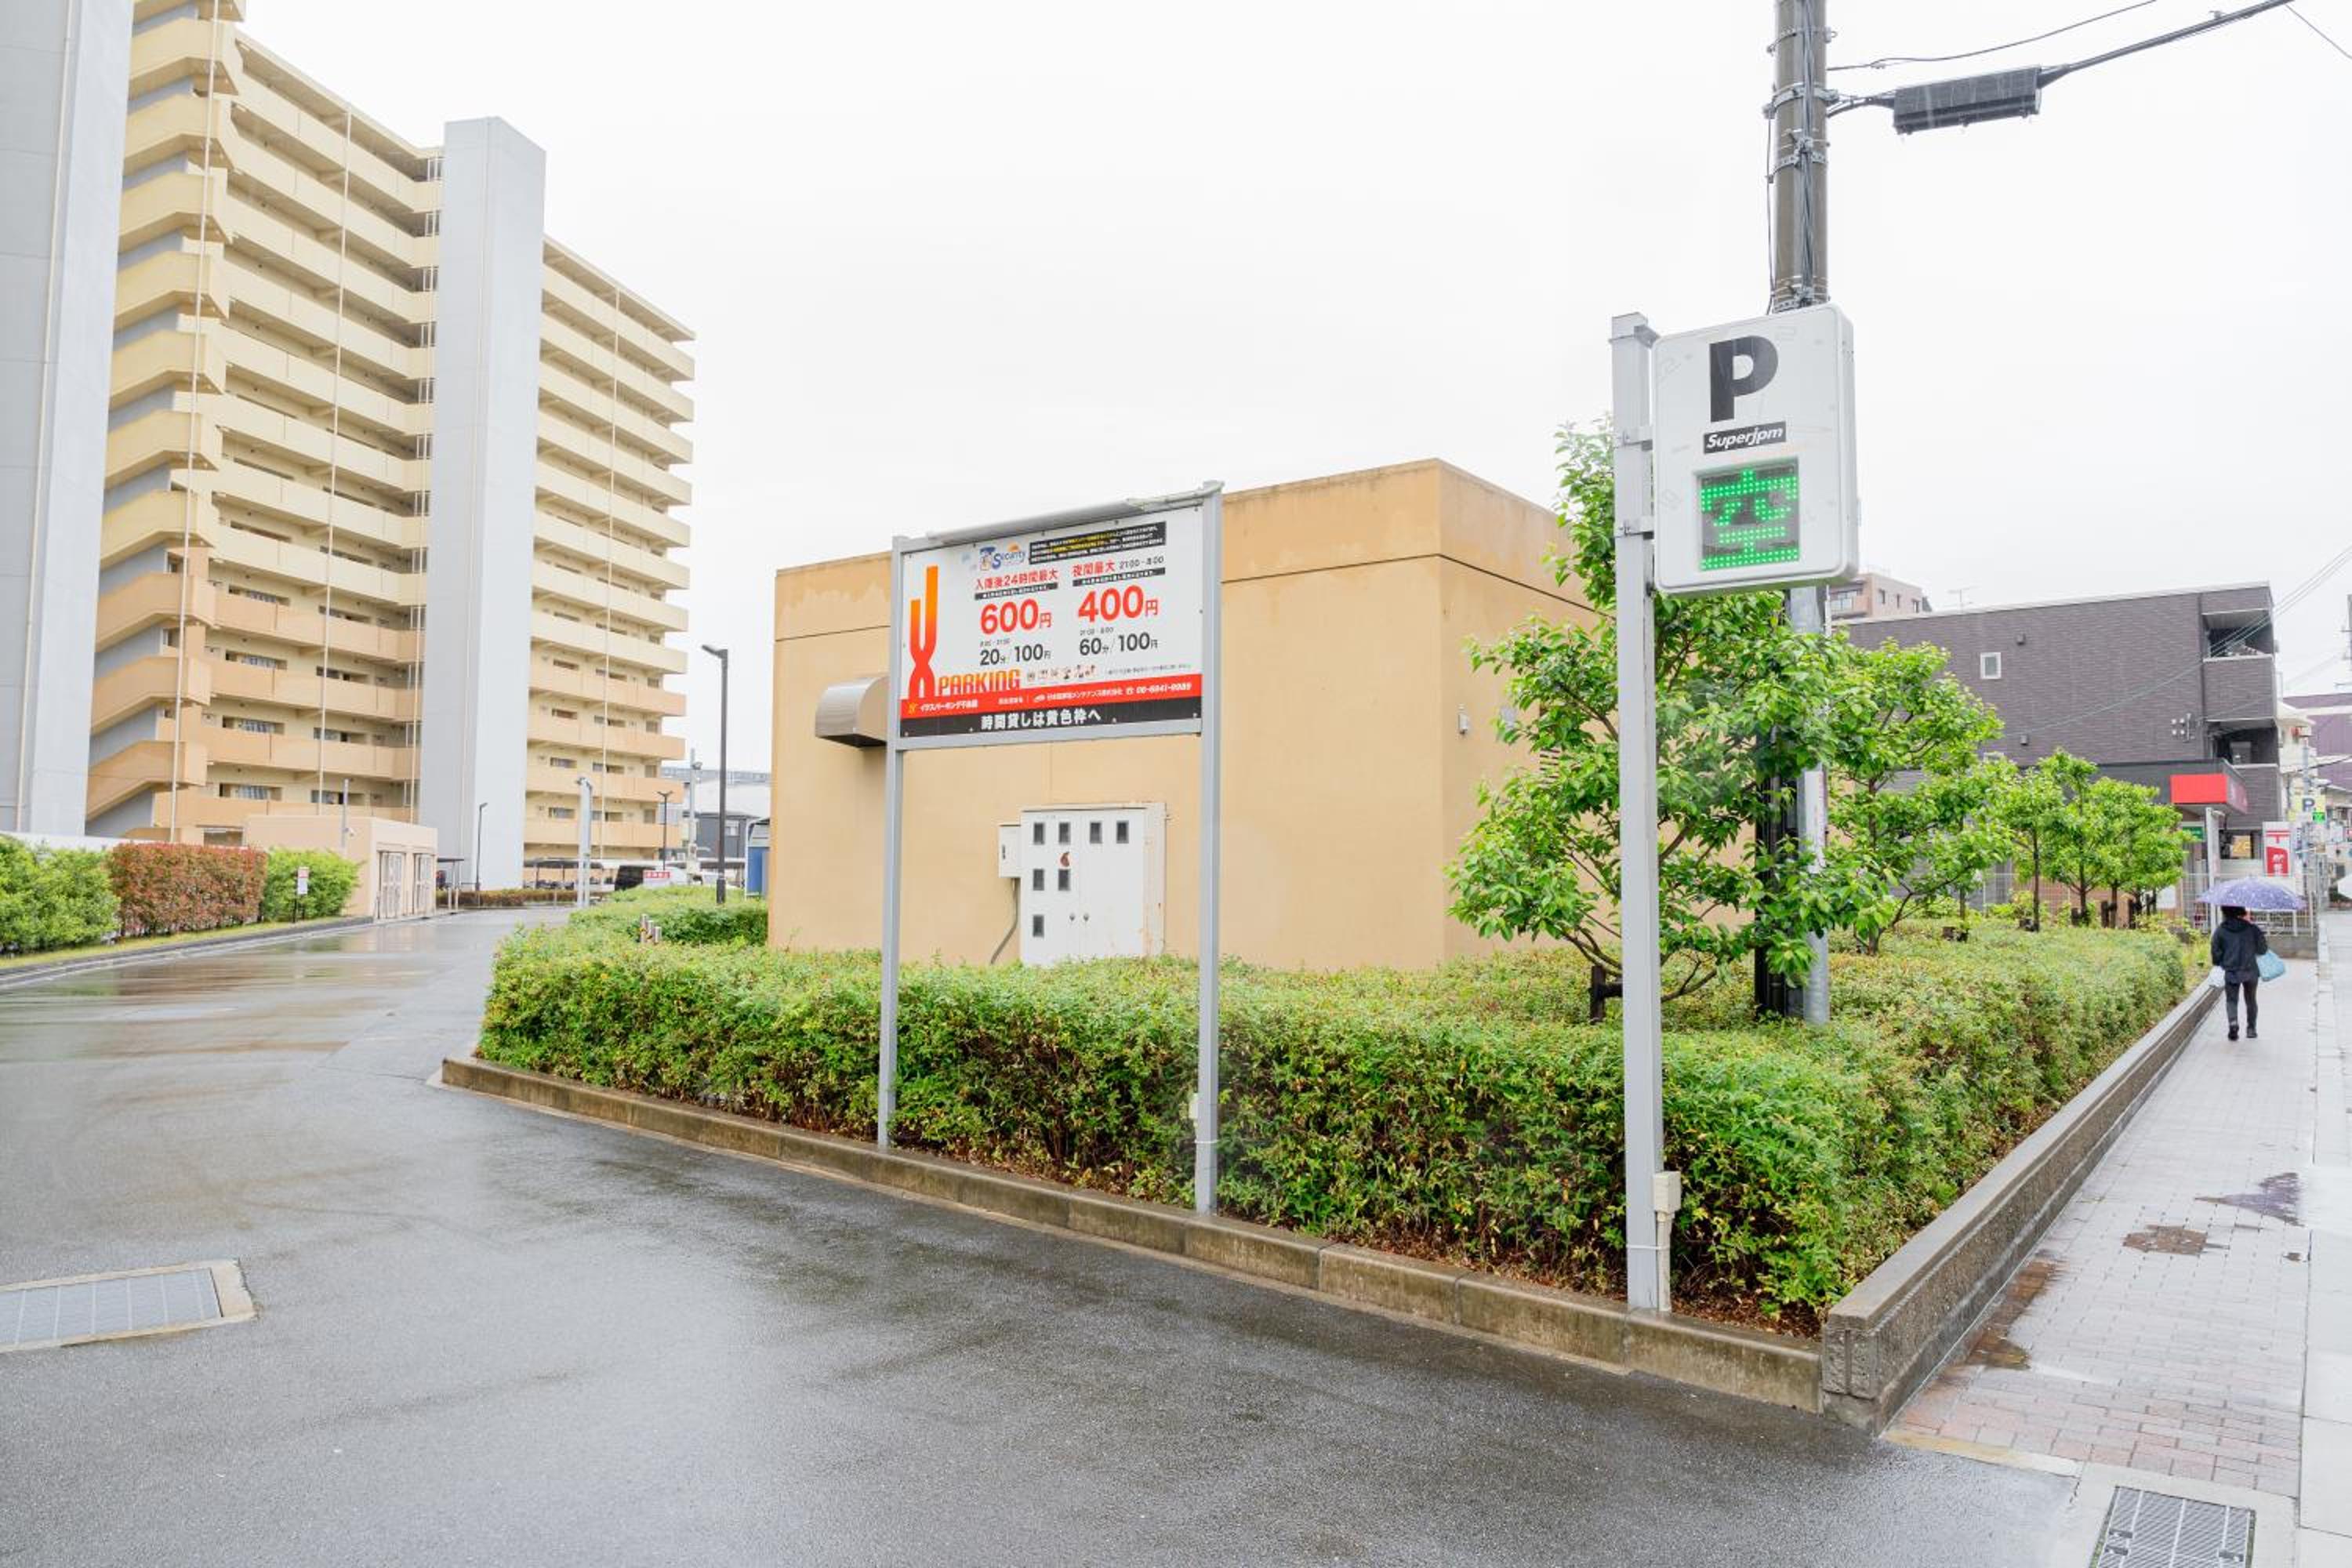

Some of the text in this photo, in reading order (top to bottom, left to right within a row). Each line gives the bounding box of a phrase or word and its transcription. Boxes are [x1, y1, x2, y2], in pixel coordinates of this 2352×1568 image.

[1709, 335, 1779, 423] P
[1706, 425, 1784, 449] Superjpm
[1700, 470, 1798, 570] 空
[981, 599, 1051, 635] 600円
[1078, 585, 1158, 622] 400円
[940, 669, 1021, 697] PARKING
[981, 707, 1102, 731] 時間貸しは黄色枠へ
